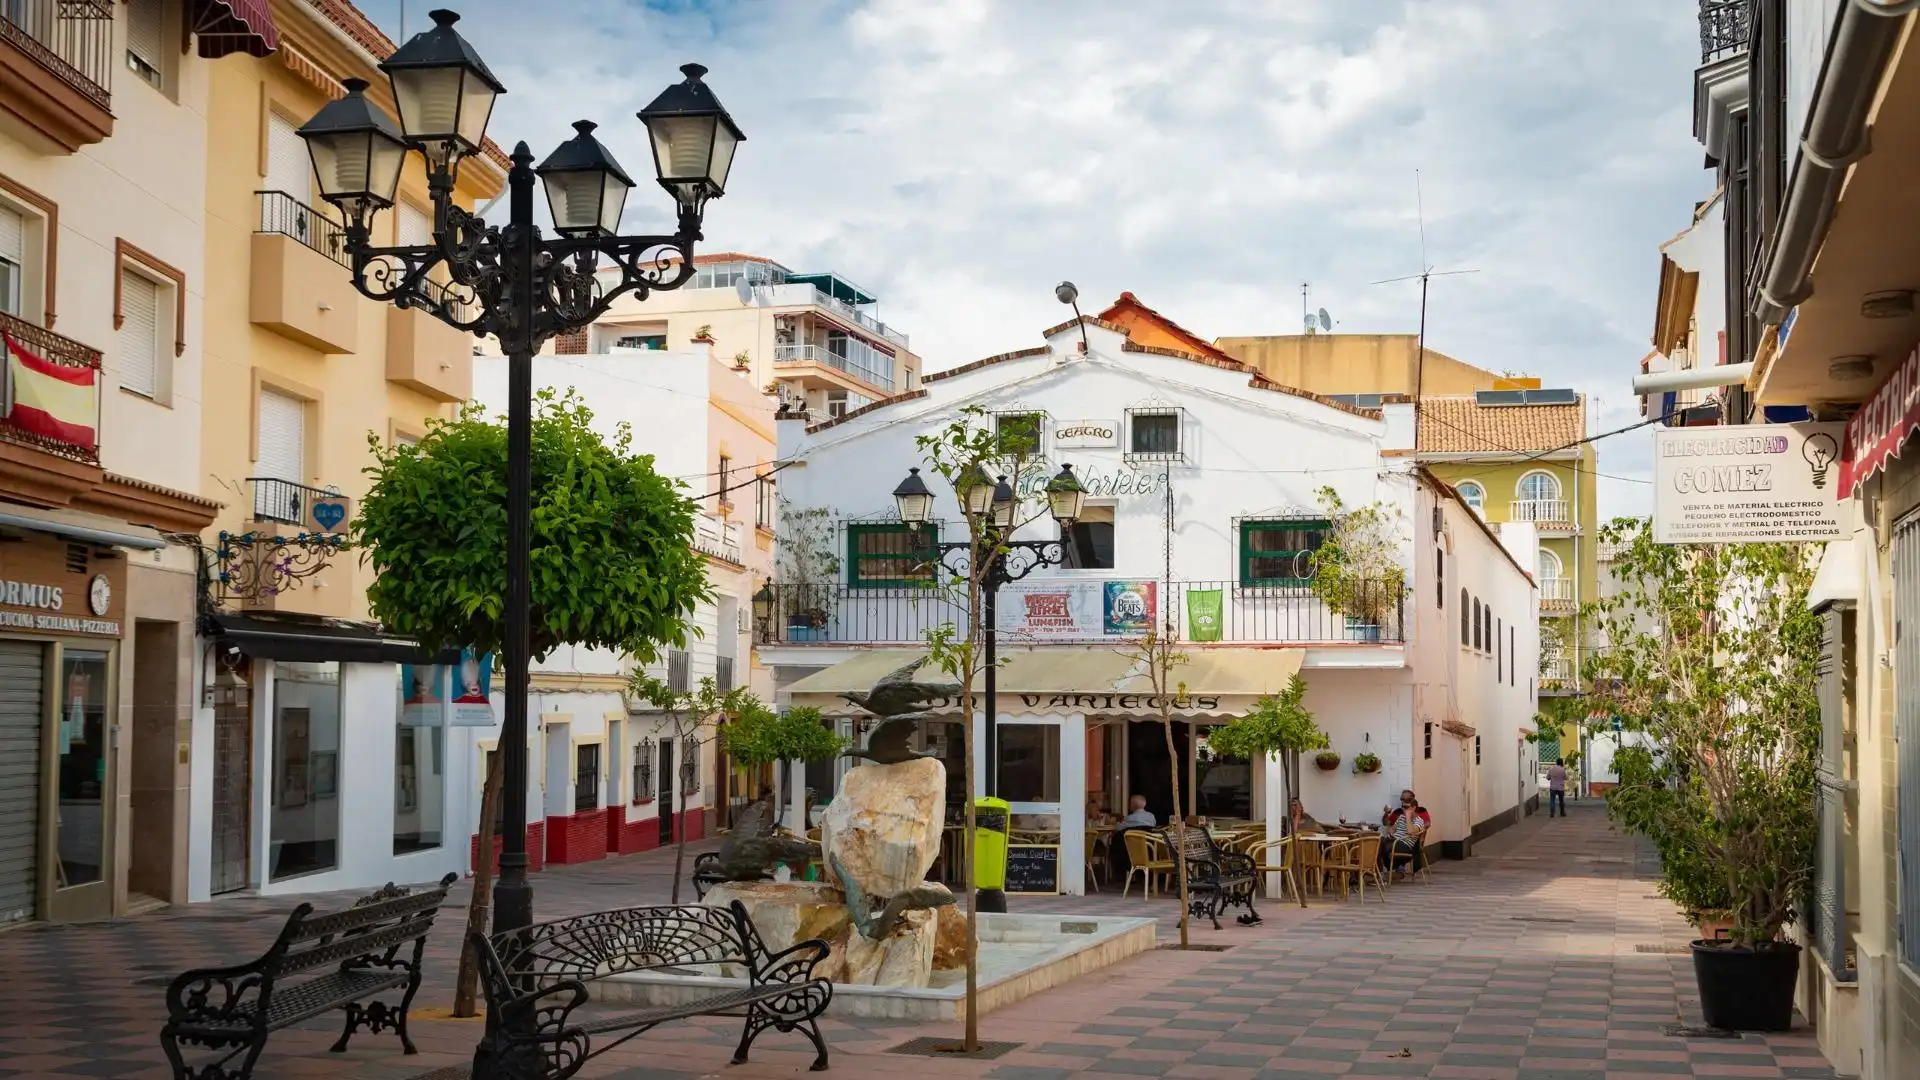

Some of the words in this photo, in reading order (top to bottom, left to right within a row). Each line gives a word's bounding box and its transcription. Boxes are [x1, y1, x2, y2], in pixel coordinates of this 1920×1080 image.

[1663, 436, 1788, 457] ELECTRICIDAD
[1674, 464, 1772, 494] GOMEZ
[1773, 500, 1824, 508] ELECTRICO
[1729, 510, 1821, 518] ELECTRODOMESTICO
[1732, 520, 1770, 528] METRIAL
[1715, 529, 1782, 537] REPARACIONES
[1785, 528, 1840, 536] ELECTRICAS
[1118, 599, 1141, 614] BEATS
[1028, 618, 1074, 627] LUNGFISH
